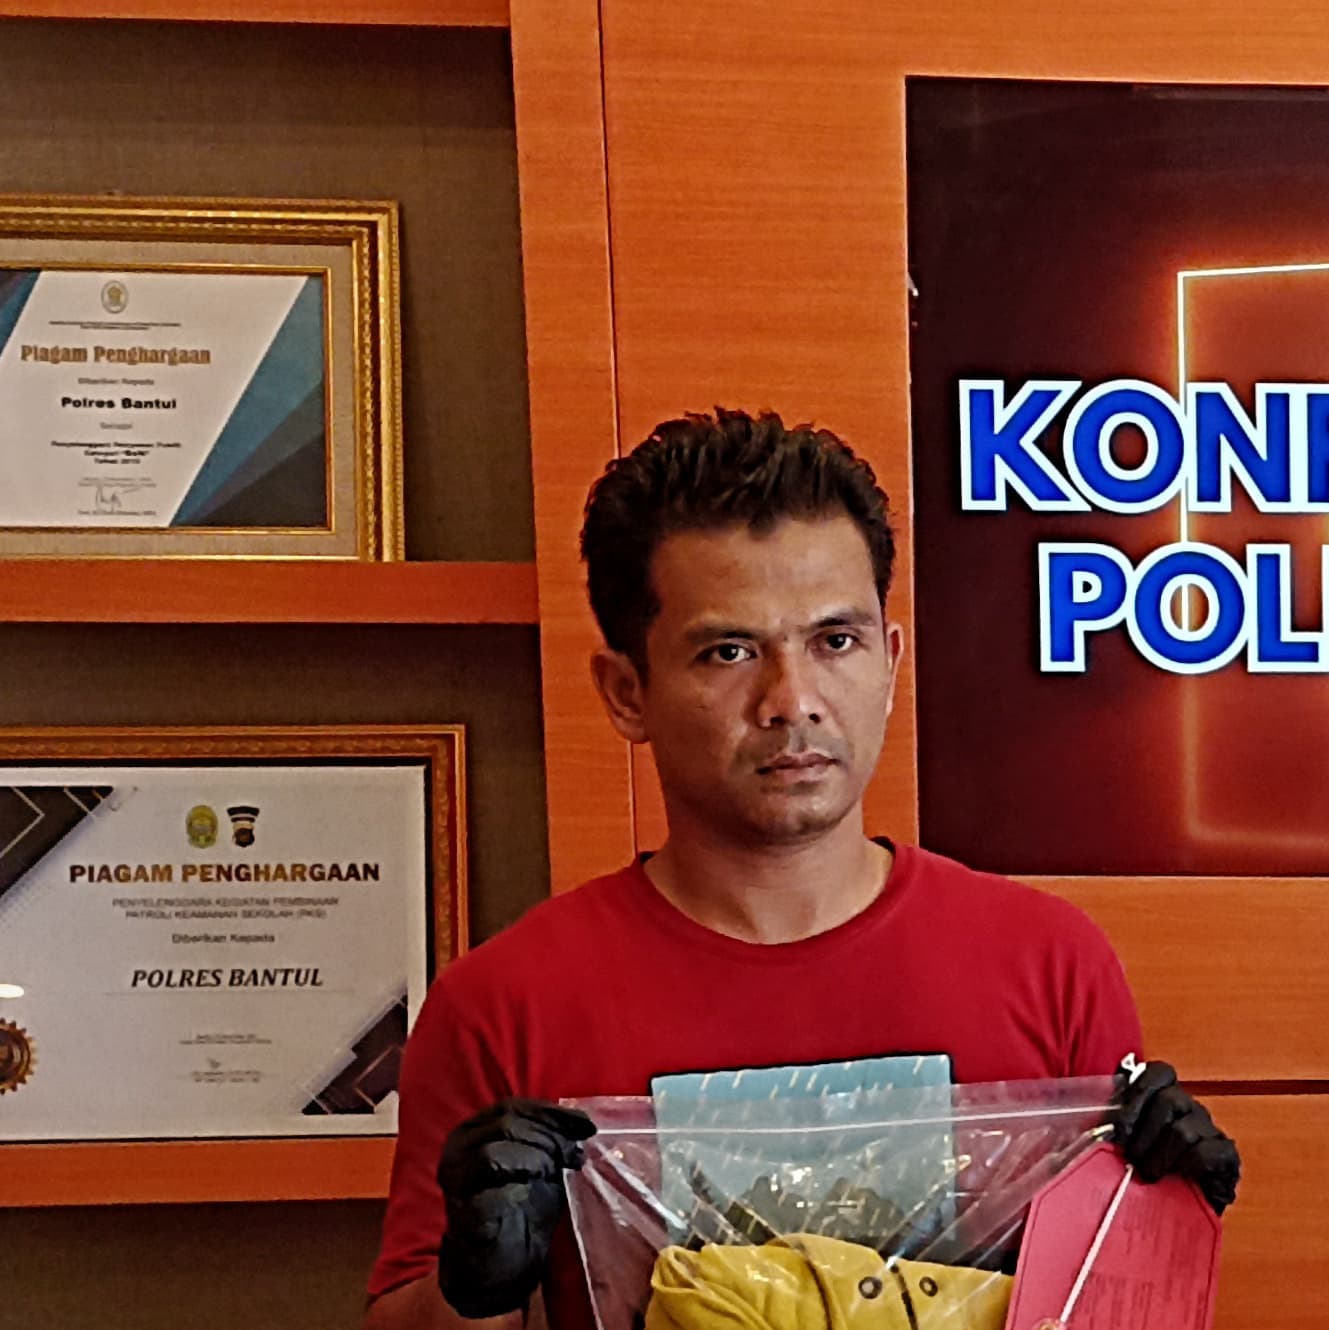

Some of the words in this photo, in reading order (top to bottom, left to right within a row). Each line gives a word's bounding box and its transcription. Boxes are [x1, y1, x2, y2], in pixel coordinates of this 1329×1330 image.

[21, 345, 88, 364] Piagam
[94, 345, 211, 366] Penghargaan
[61, 397, 115, 409] Polres
[121, 397, 177, 409] Bantul
[70, 864, 172, 883] PIAGAM
[182, 862, 380, 882] PENGHARGAAN
[131, 969, 222, 988] POLRES
[228, 968, 324, 988] BANTUL
